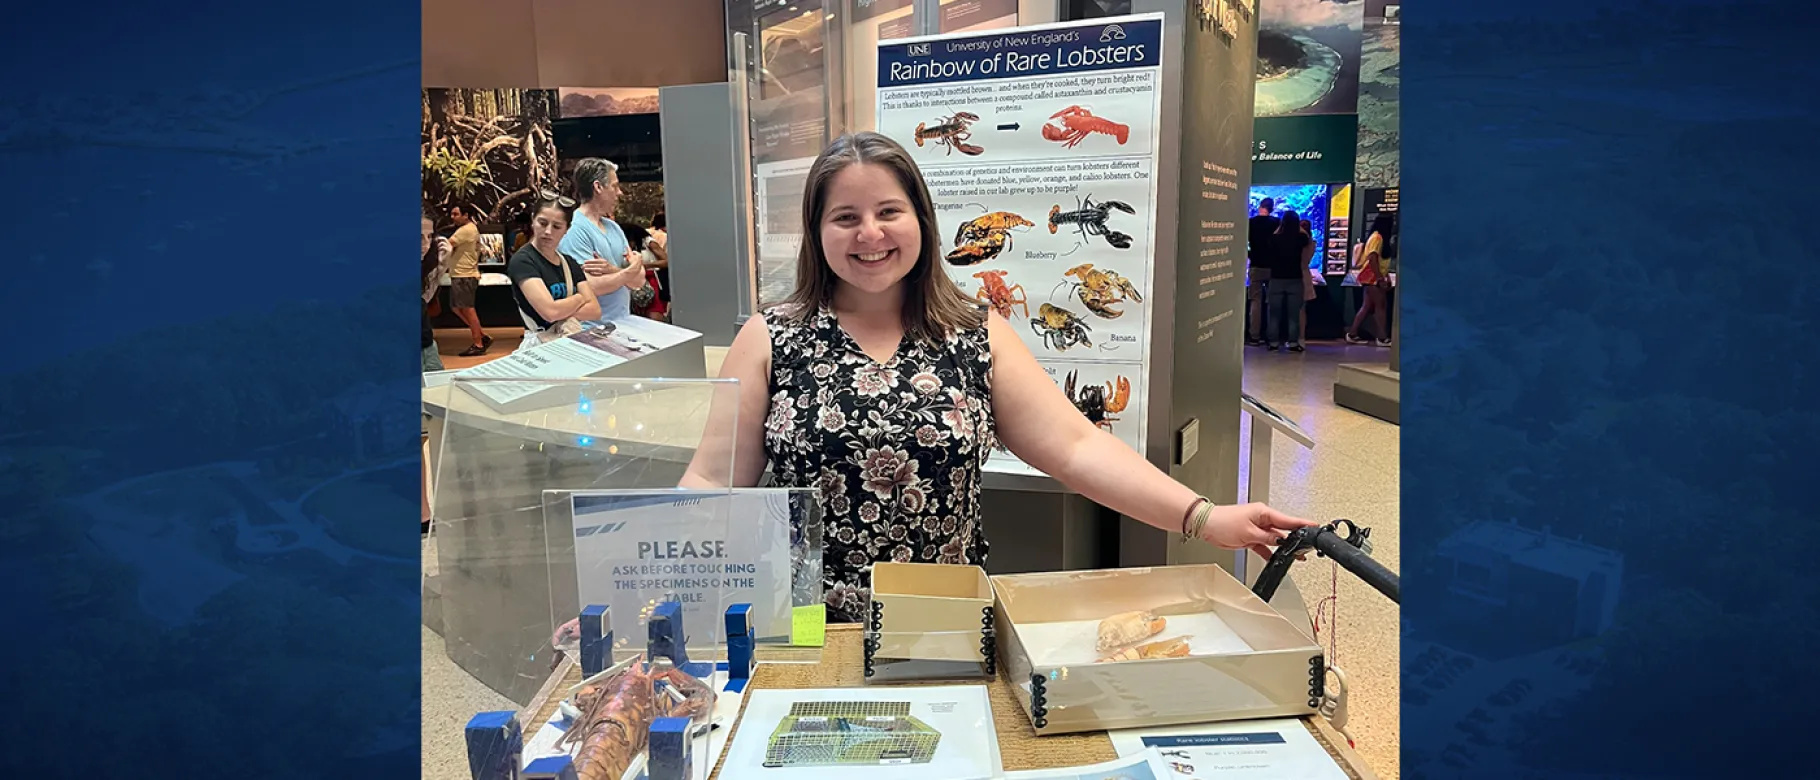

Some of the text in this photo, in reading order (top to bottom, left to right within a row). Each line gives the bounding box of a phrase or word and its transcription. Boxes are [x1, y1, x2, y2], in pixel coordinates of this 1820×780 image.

[946, 31, 1080, 52] University of New England's
[908, 43, 930, 55] UNE
[890, 43, 1145, 81] Rainbow of Rare Lobsters
[999, 83, 1011, 91] and
[1013, 82, 1030, 90] when
[1031, 80, 1053, 90] they're
[1081, 76, 1096, 87] they
[1097, 76, 1112, 84] turn
[1113, 73, 1134, 85] bright
[1135, 73, 1151, 81] red!
[883, 102, 897, 110] This
[902, 100, 922, 109] thanks
[930, 98, 966, 106] interactions
[967, 96, 993, 104] between
[999, 92, 1033, 103] compound
[1034, 91, 1054, 99] called
[1094, 87, 1107, 95] and
[1259, 152, 1293, 160] Balance
[1295, 152, 1305, 160] of
[1306, 151, 1322, 159] Life
[927, 169, 965, 177] combination
[972, 167, 997, 176] genetics
[998, 166, 1010, 174] and
[1011, 164, 1053, 174] environment
[1082, 162, 1109, 171] lobsters
[1110, 160, 1140, 169] different
[976, 177, 1000, 185] donated
[1133, 171, 1149, 179] One
[937, 188, 959, 196] lobster
[960, 188, 978, 196] raised
[999, 187, 1009, 195] lab
[1010, 187, 1026, 196] grew
[1027, 187, 1036, 195] up
[1037, 185, 1044, 193] to
[1044, 185, 1053, 193] be
[1053, 184, 1078, 194] purple!
[933, 203, 963, 212] Tangerine
[1025, 250, 1057, 261] Blueberry
[1110, 333, 1136, 342] Banana
[612, 565, 639, 576] ASK
[641, 564, 688, 575] BEFORE
[614, 577, 755, 590] THE SPECIMENS ON THE
